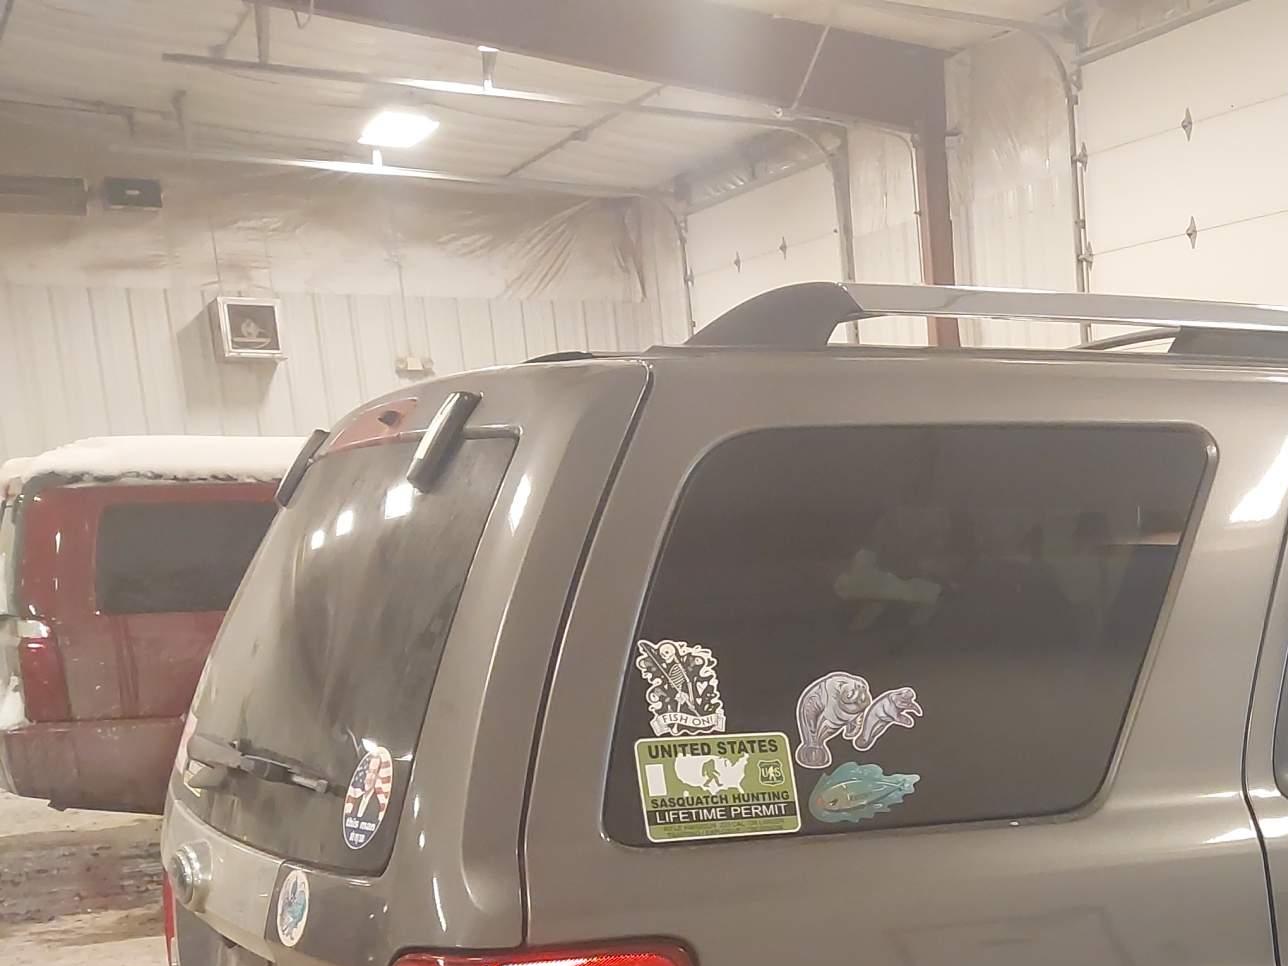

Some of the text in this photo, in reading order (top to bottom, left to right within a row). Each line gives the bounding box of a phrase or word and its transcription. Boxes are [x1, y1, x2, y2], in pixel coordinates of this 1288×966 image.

[662, 714, 713, 726] FISH ON!
[648, 739, 778, 759] UNITED STATES
[651, 790, 790, 809] SASQUATCH HUNTING
[655, 803, 788, 824] LIFETIME PERMIT
